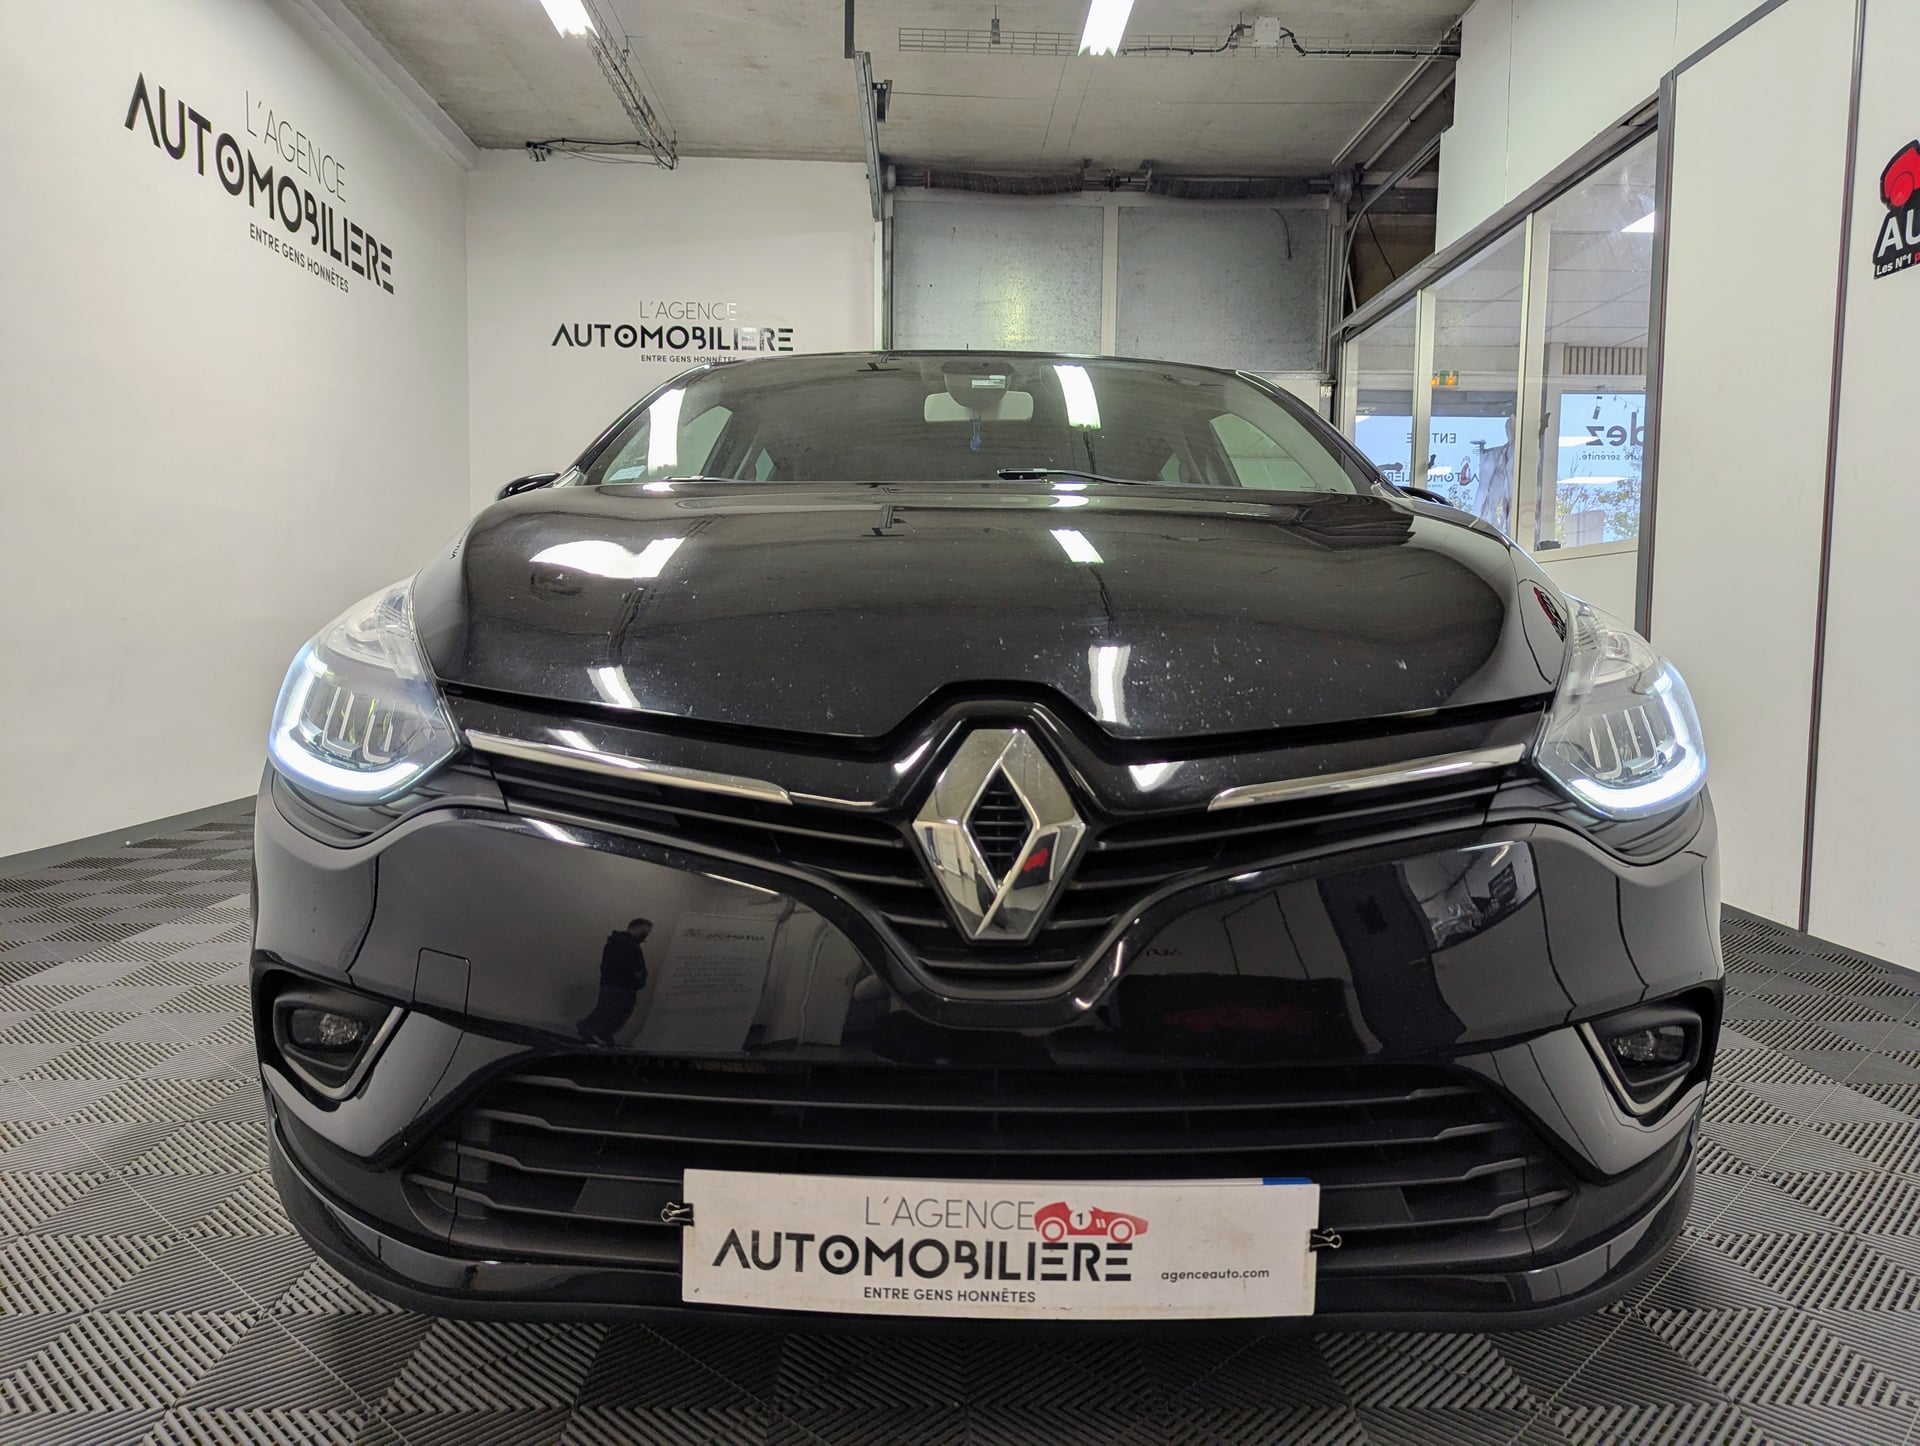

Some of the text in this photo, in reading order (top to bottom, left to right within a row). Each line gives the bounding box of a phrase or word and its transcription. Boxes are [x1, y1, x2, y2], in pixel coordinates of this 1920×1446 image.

[246, 90, 346, 203] L'AGENCE
[124, 71, 394, 295] AUTOMOBILIERE
[249, 222, 349, 293] ENTRE GENS HONNÊTES
[1876, 261, 1893, 276] Les
[639, 300, 737, 321] L'AGENCE
[551, 322, 794, 352] AUTOMOBILIERE
[641, 354, 668, 363] ENTRE
[669, 355, 692, 363] GENS
[864, 1195, 1036, 1230] L'AGENCE
[711, 1227, 1133, 1282] AUTOMOBILIERE
[1160, 1267, 1270, 1283] agenceauto.com
[863, 1286, 1036, 1303] ENTRE GENS HONNÊTES
